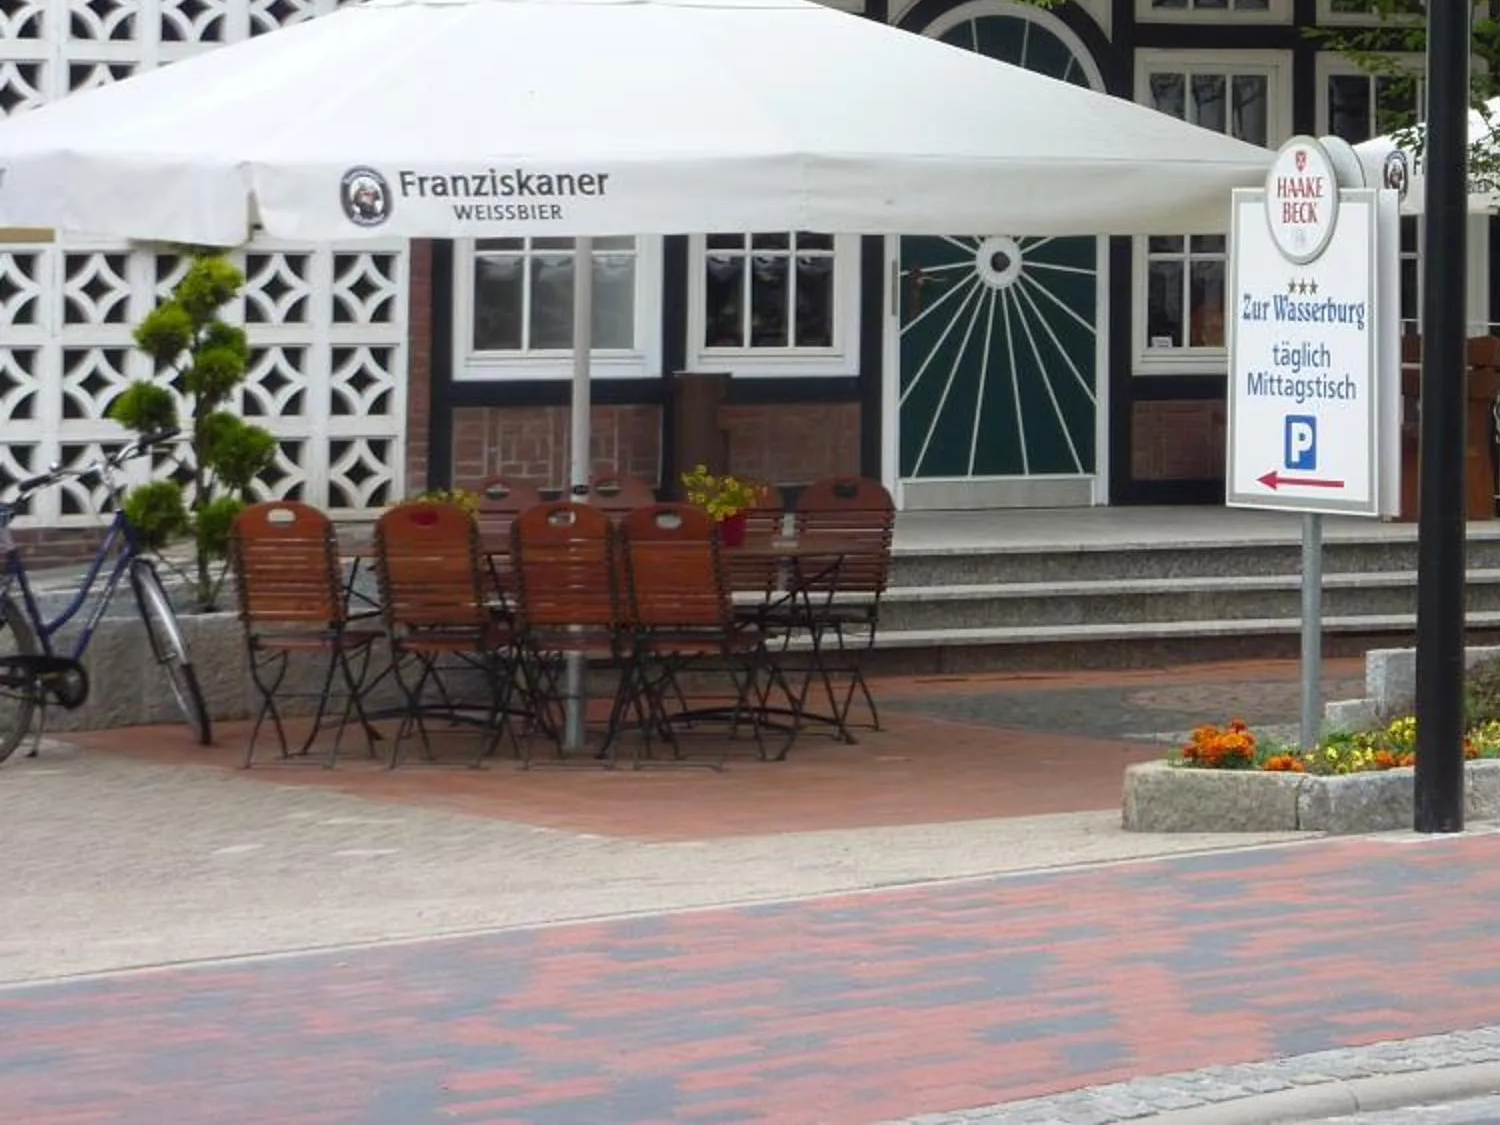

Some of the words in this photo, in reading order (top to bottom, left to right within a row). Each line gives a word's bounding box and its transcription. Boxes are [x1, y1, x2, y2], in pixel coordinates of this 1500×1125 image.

[399, 169, 610, 197] Franziskaner
[1277, 176, 1324, 198] HAAKE
[453, 203, 563, 221] WEISSBIER
[1282, 201, 1319, 224] BECK
[1242, 292, 1270, 321] Zur
[1273, 293, 1365, 331] Wasserburg
[1272, 340, 1332, 374] täglich
[1246, 371, 1357, 405] Mittagstisch
